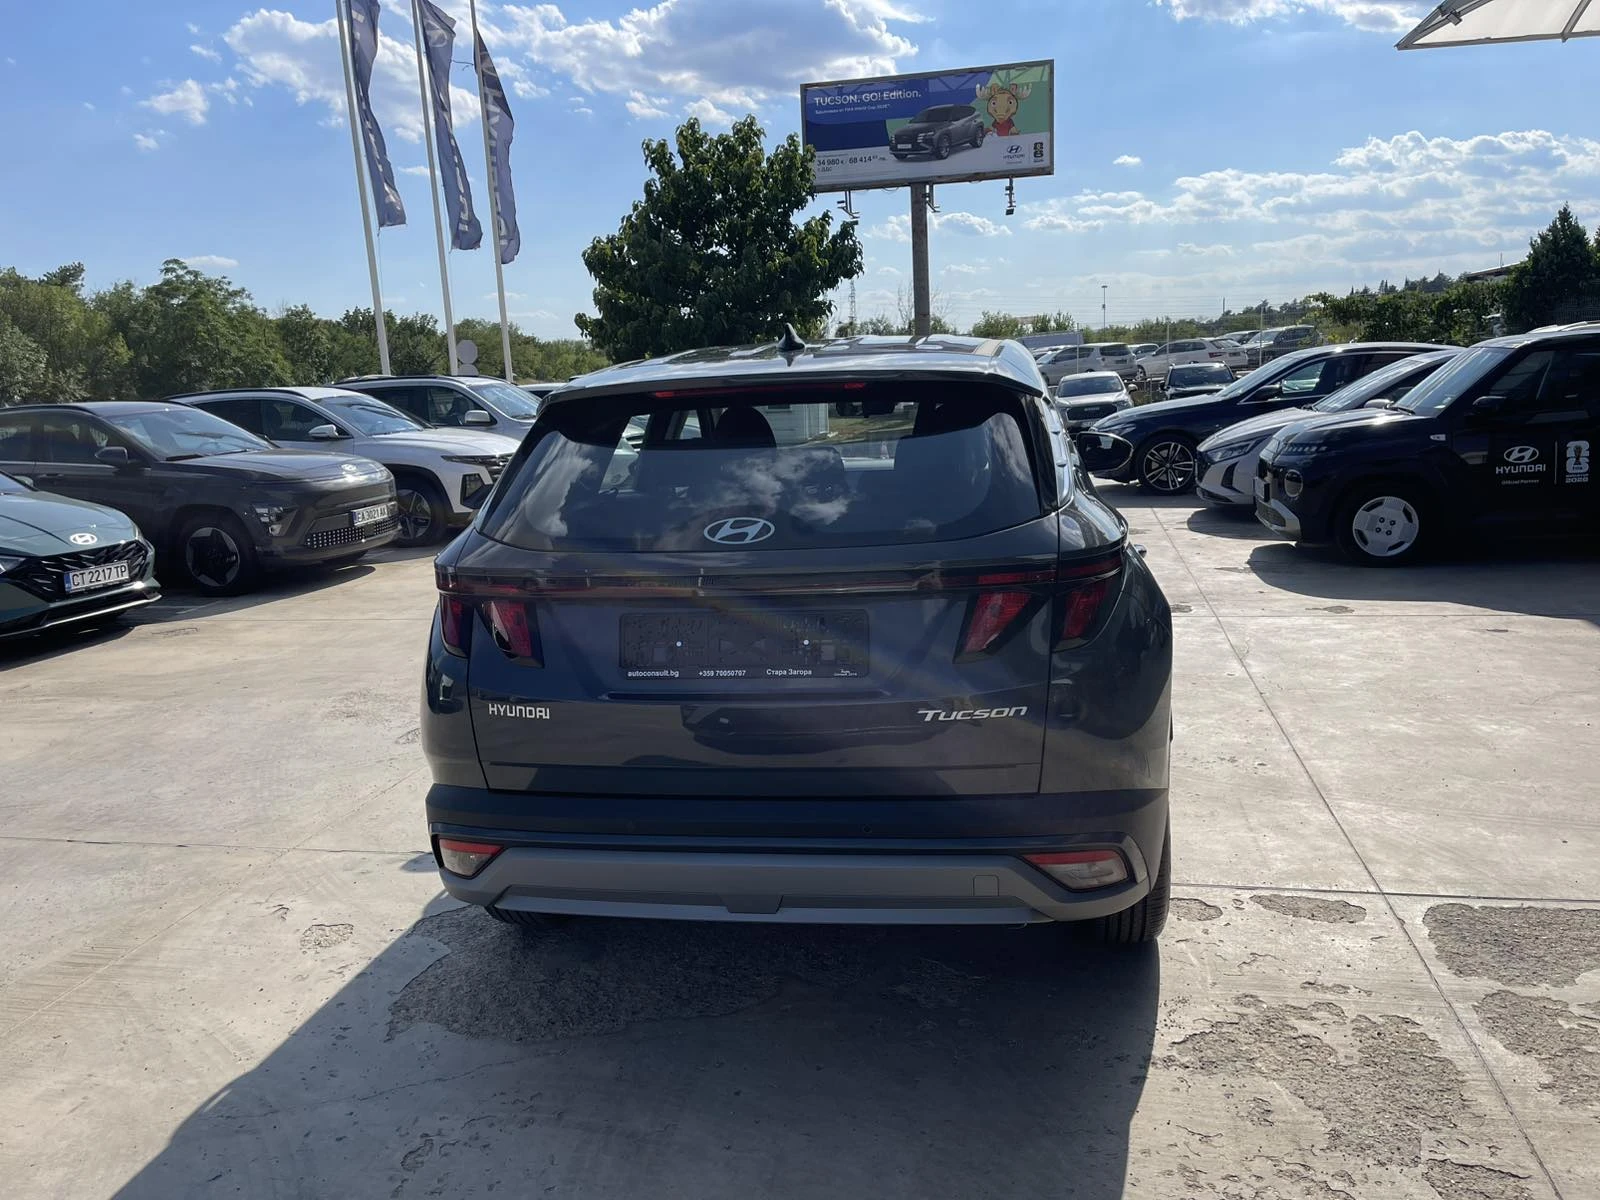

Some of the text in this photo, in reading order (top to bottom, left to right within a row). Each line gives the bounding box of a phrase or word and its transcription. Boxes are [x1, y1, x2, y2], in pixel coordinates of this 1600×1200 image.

[814, 89, 922, 106] TUCSON. GO! Edition.
[1495, 464, 1547, 474] HYUNDAI
[72, 565, 126, 587] CT 2217 TP
[627, 669, 680, 678] autoconsult.bg
[766, 668, 812, 676] Стара Загора
[488, 703, 550, 719] HYUNDAI
